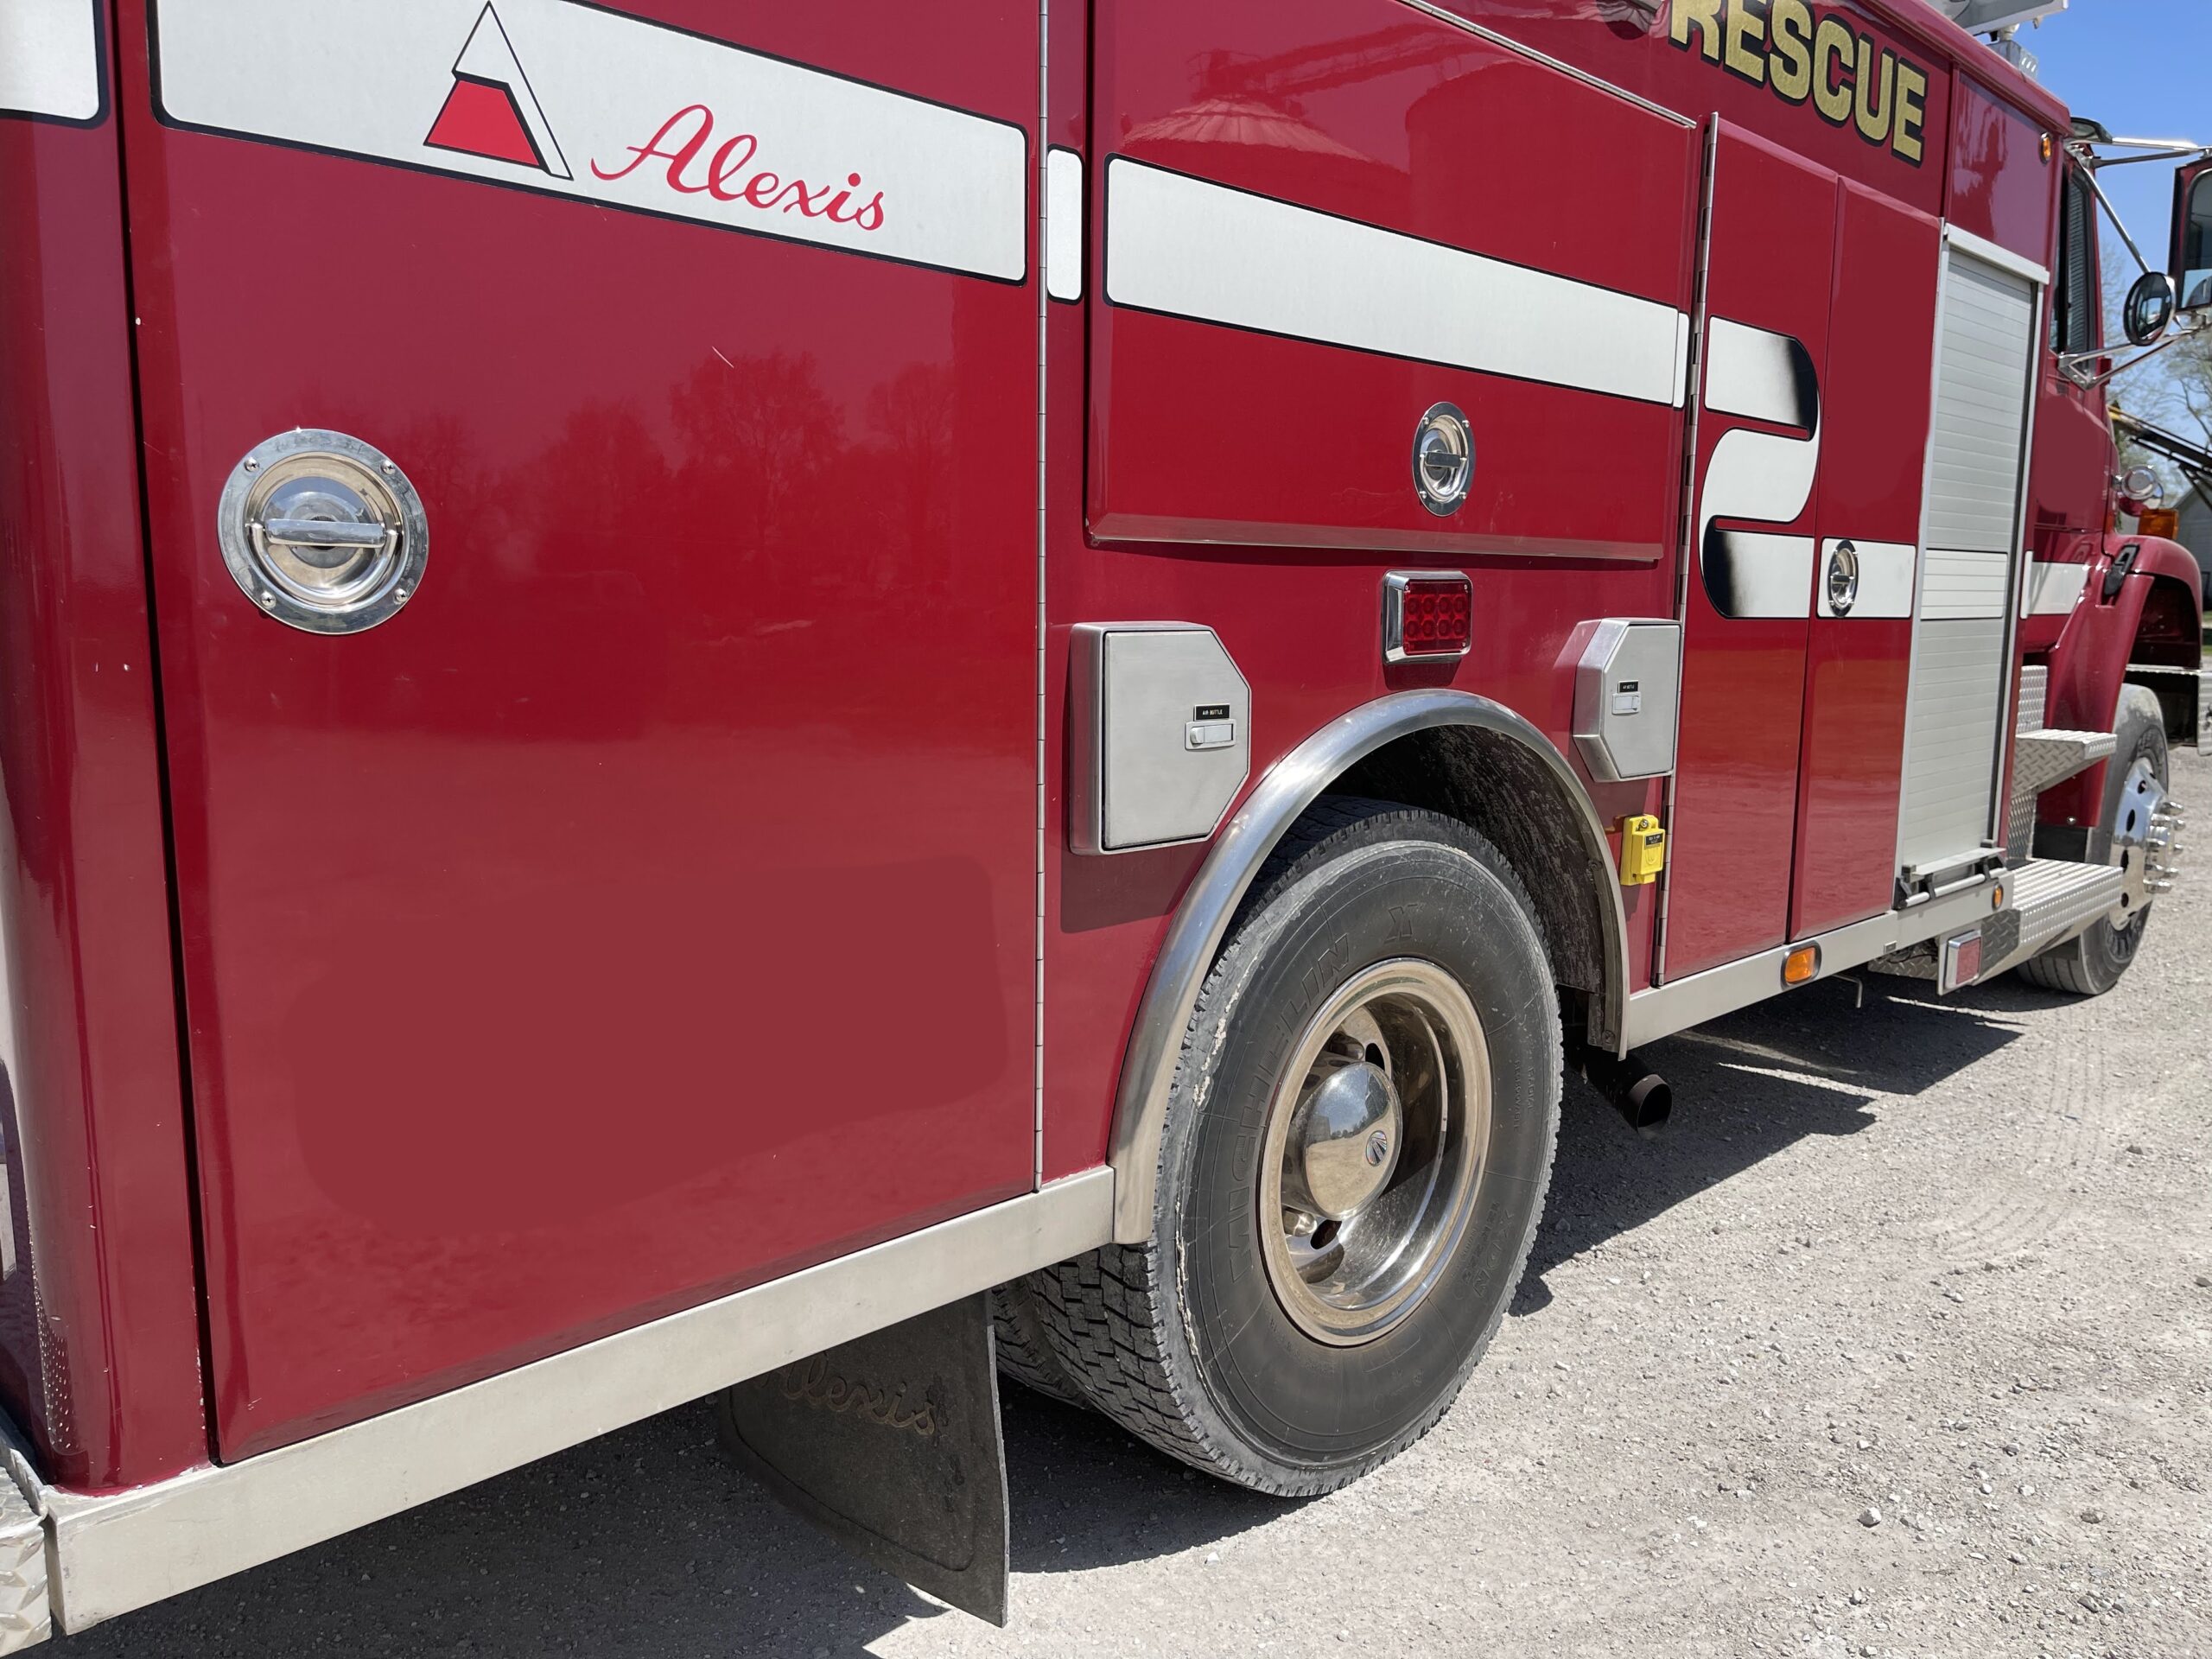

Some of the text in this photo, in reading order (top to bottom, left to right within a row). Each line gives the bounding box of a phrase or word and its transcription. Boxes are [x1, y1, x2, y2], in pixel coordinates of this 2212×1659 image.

[1669, 0, 1928, 167] RESCUE
[591, 104, 884, 231] Alexis
[753, 1348, 935, 1437] lexis
